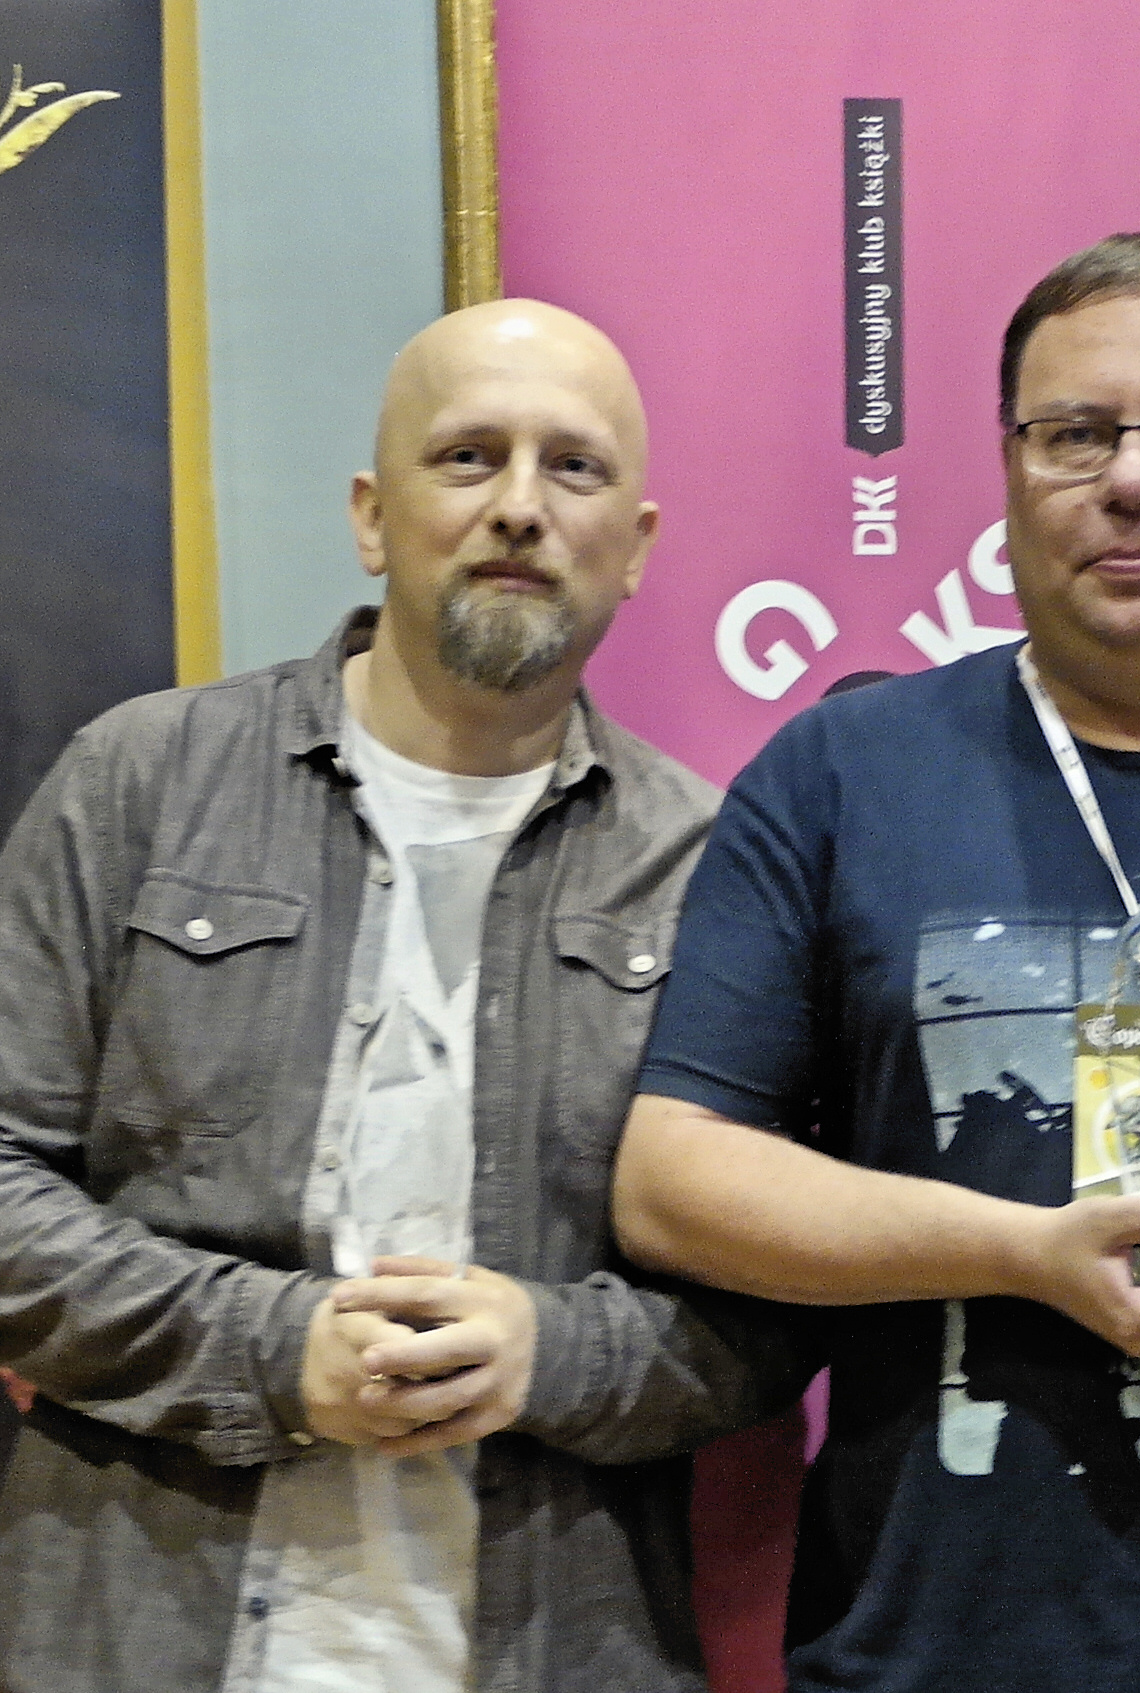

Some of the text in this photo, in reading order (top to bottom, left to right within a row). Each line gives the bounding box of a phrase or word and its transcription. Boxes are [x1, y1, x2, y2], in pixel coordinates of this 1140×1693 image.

[857, 116, 892, 434] dyskusyjny klub książki
